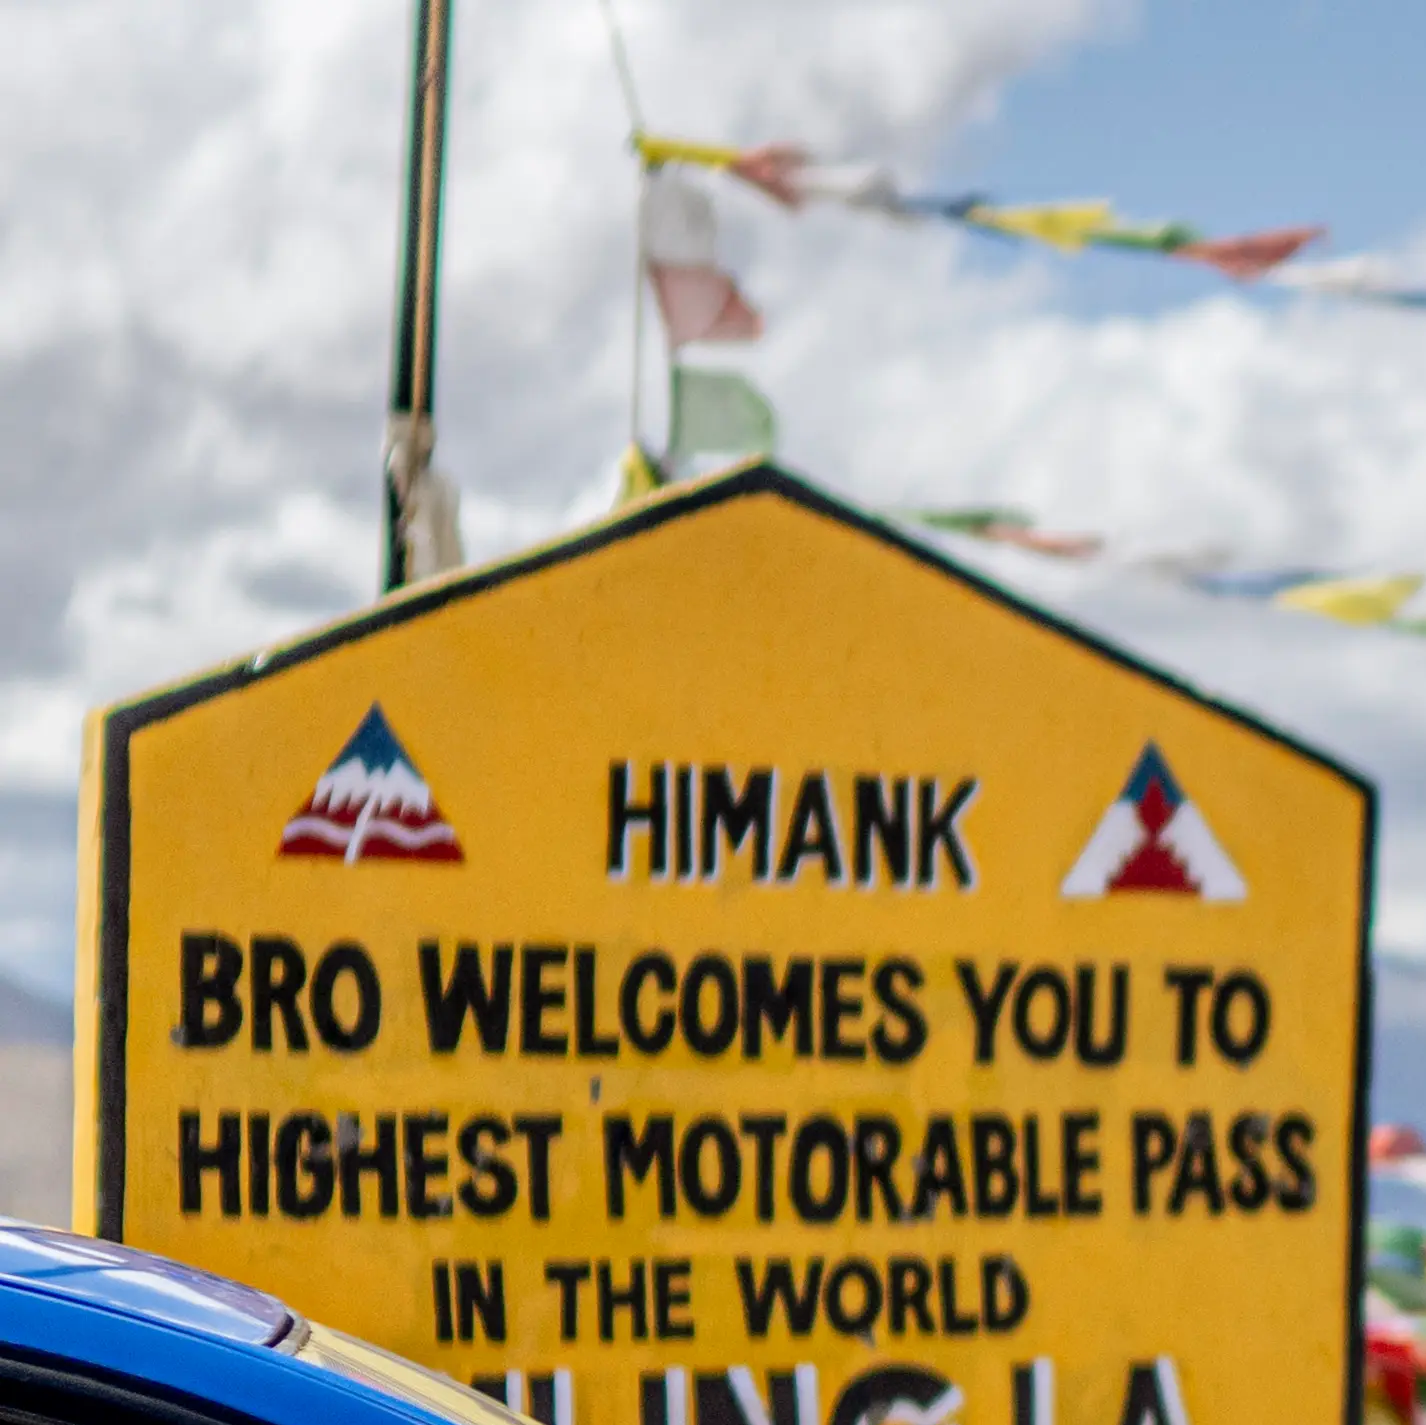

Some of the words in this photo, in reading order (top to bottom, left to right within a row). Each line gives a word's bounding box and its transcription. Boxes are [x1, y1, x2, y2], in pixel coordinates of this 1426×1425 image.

[606, 760, 982, 891] HIMANK
[175, 931, 382, 1056] BRO
[416, 939, 930, 1067] WELCOMES
[954, 958, 1131, 1069] YOU
[1162, 965, 1273, 1068] TO
[177, 1108, 564, 1223] HIGHEST
[602, 1109, 1105, 1226] MOTORABLE
[1130, 1110, 1317, 1215] PASS
[432, 1258, 508, 1344] IN
[542, 1257, 697, 1343] THE
[733, 1254, 1032, 1341] WORLD
